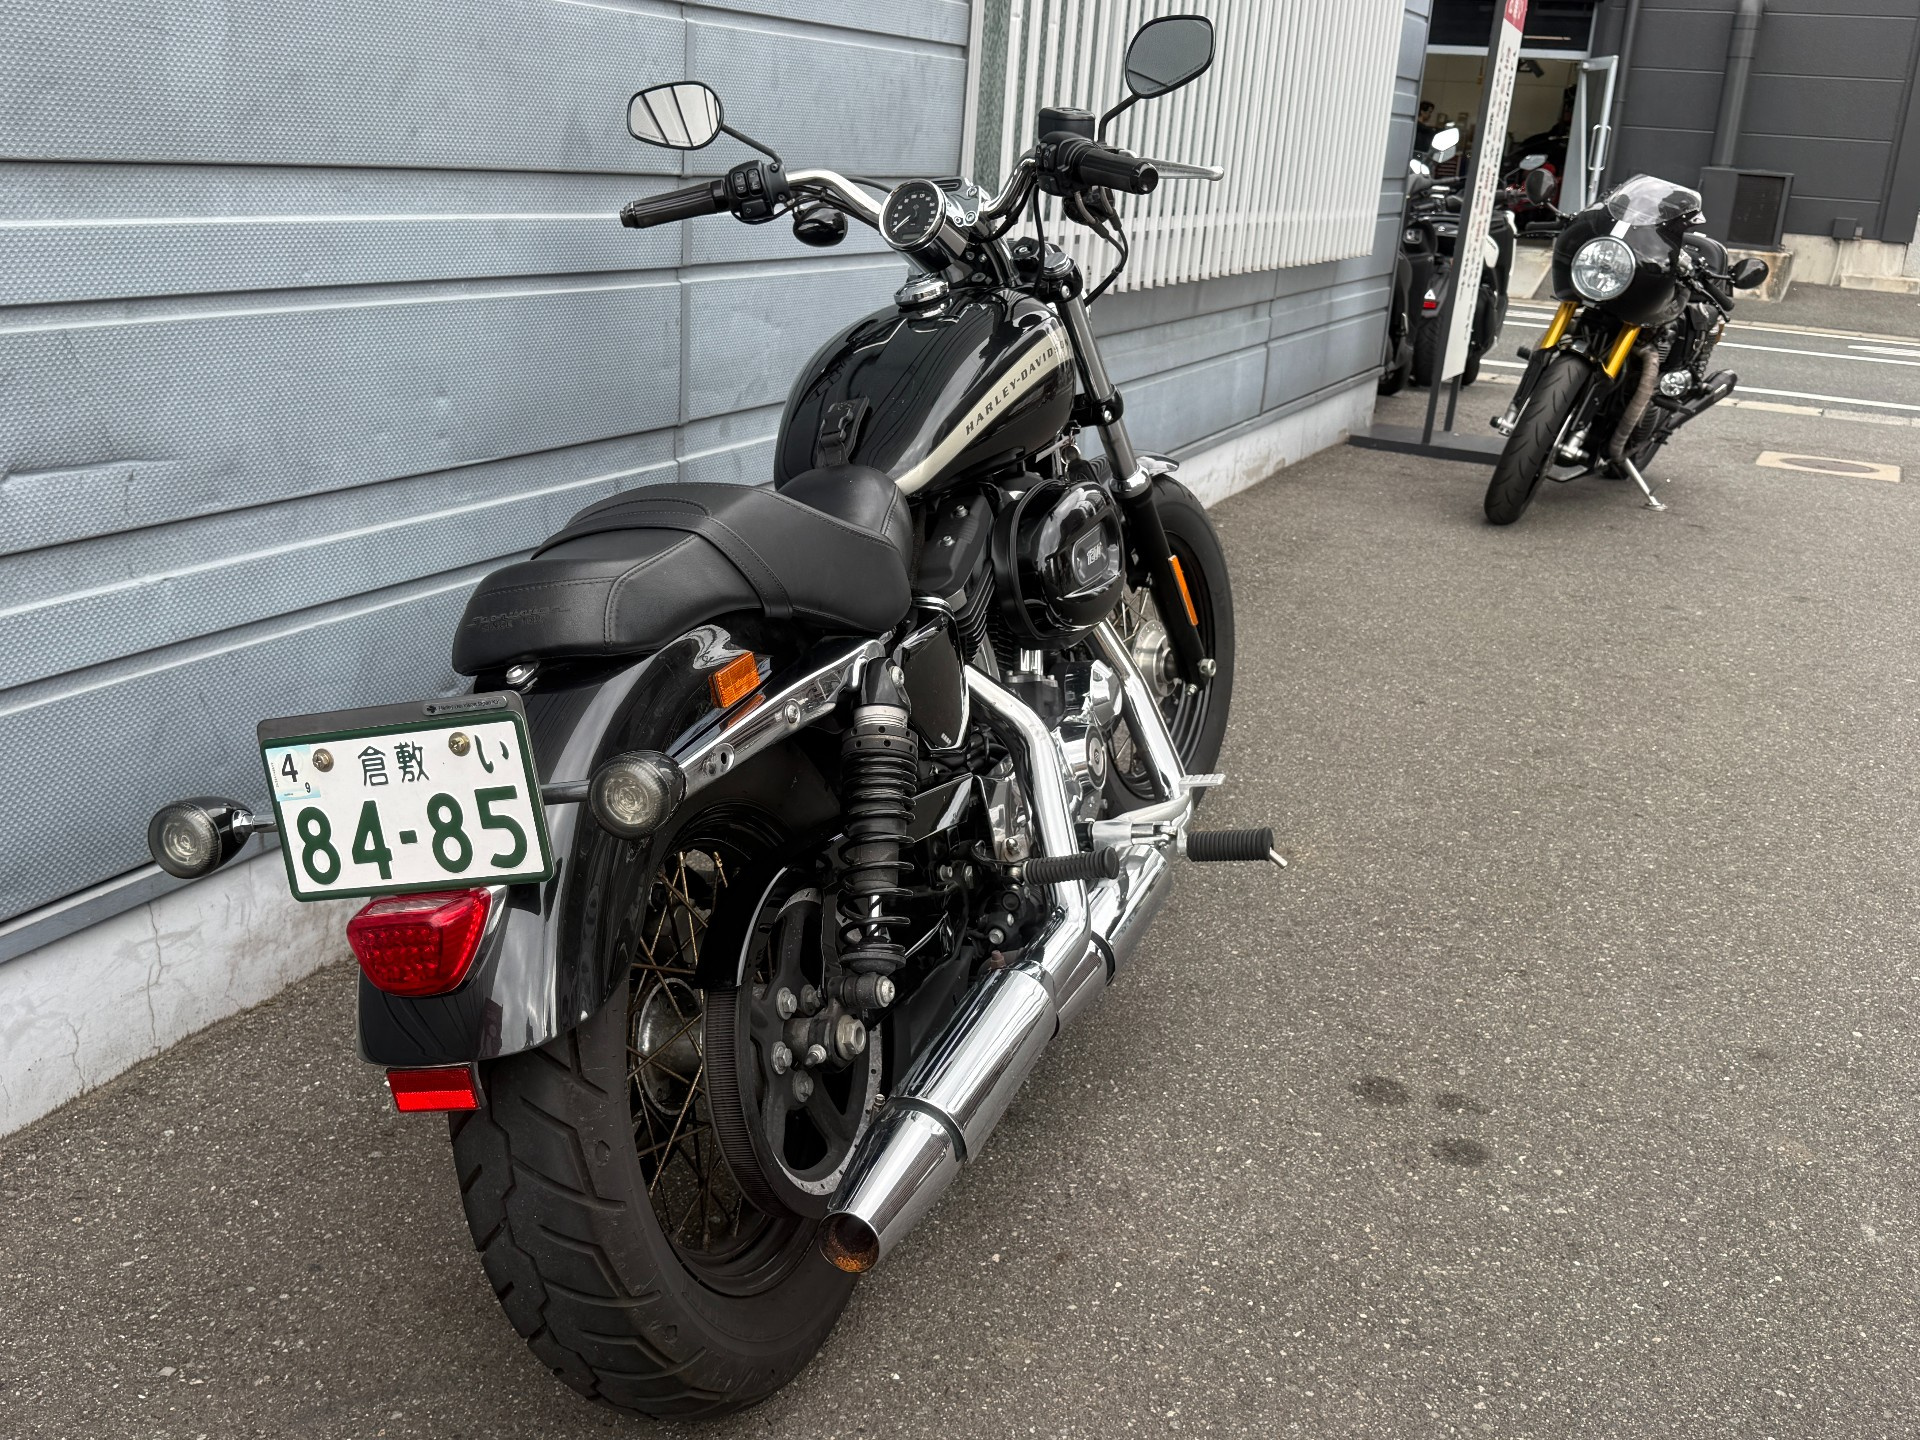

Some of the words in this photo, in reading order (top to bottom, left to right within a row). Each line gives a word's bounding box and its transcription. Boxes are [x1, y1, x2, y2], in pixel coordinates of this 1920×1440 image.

[282, 753, 298, 783] 4
[357, 740, 430, 787] 倉敷
[474, 734, 510, 774] い
[305, 781, 311, 794] 9
[296, 784, 528, 885] 84-85
